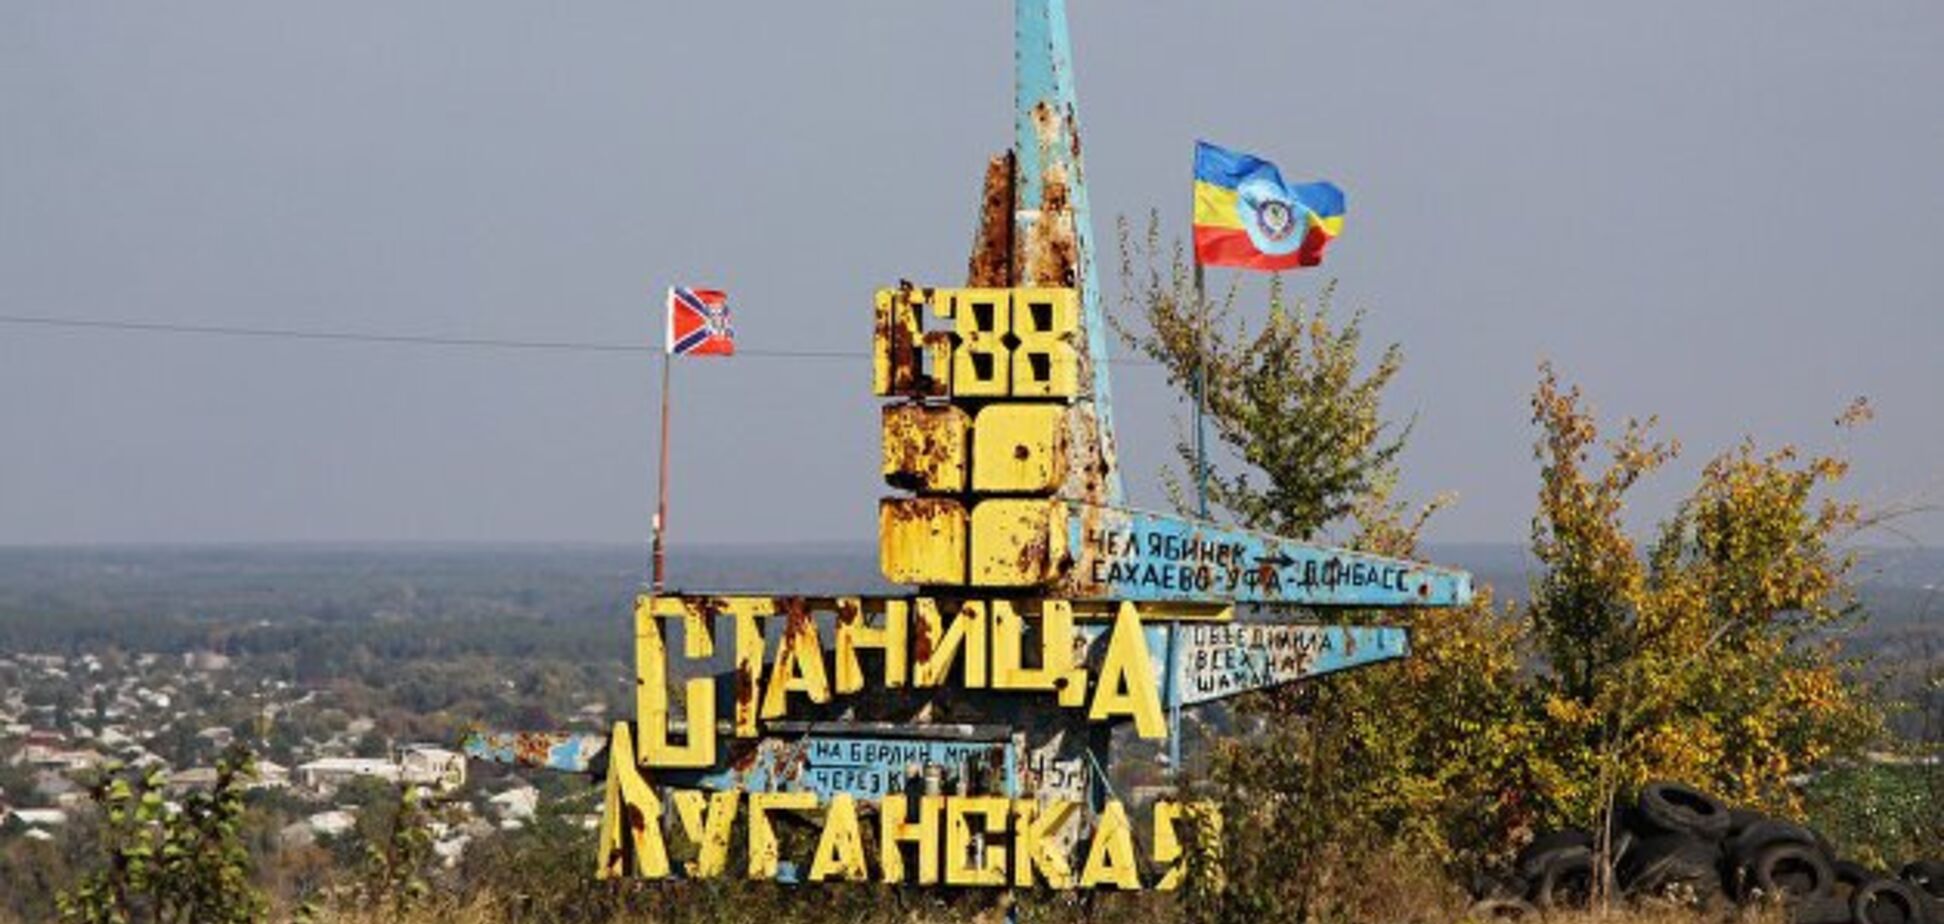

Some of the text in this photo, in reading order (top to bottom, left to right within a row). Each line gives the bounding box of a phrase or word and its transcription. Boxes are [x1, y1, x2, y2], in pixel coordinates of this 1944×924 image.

[634, 594, 1168, 768] СТАНИЦА
[816, 741, 842, 759] НА
[816, 770, 880, 794] ЧЕРЕЗ
[594, 720, 1223, 890] ЛУГАНСКАЯ
